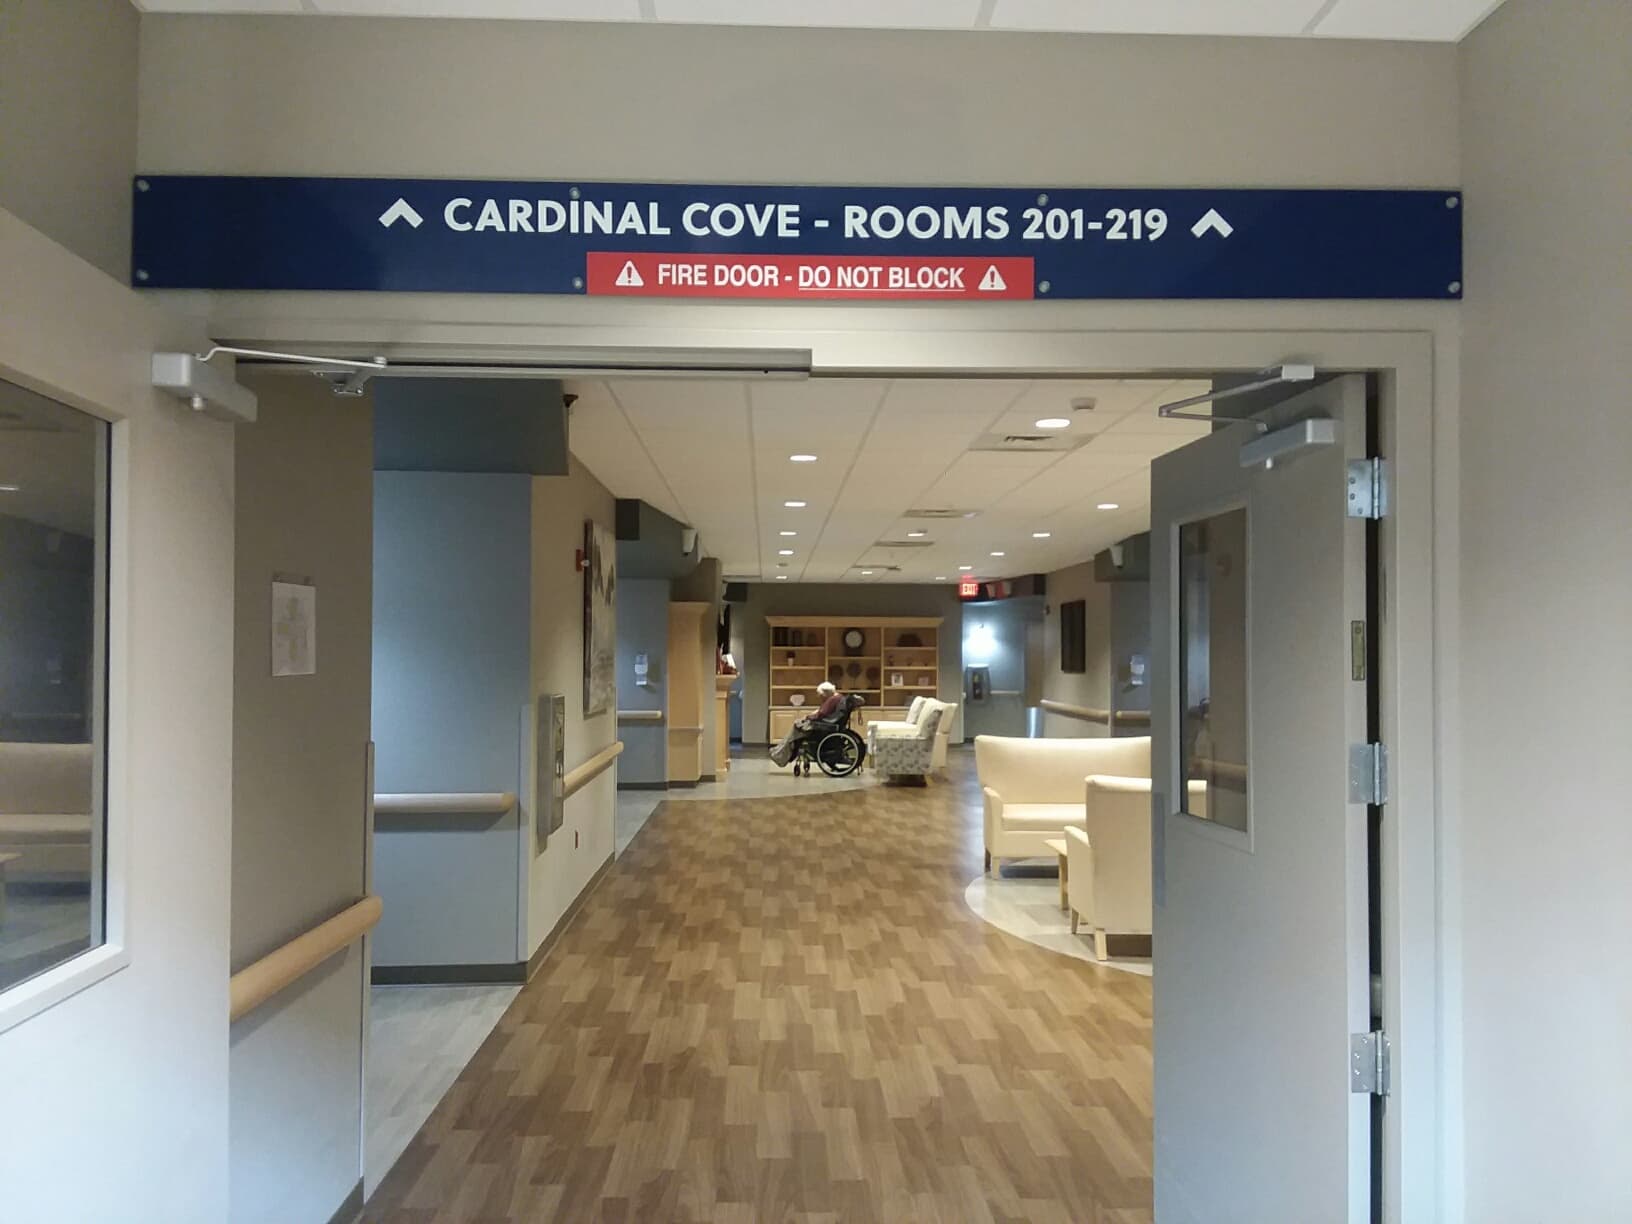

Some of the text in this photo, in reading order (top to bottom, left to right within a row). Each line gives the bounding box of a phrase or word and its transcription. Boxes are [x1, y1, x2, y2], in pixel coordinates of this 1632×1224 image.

[443, 197, 1168, 241] CARDINAL COVE - ROOMS 201-219
[658, 263, 708, 286] FIRE
[714, 264, 779, 287] DOOR
[798, 265, 831, 288] DO
[836, 265, 883, 289] NOT
[888, 266, 965, 289] BLOCK
[961, 583, 978, 596] EXIT
